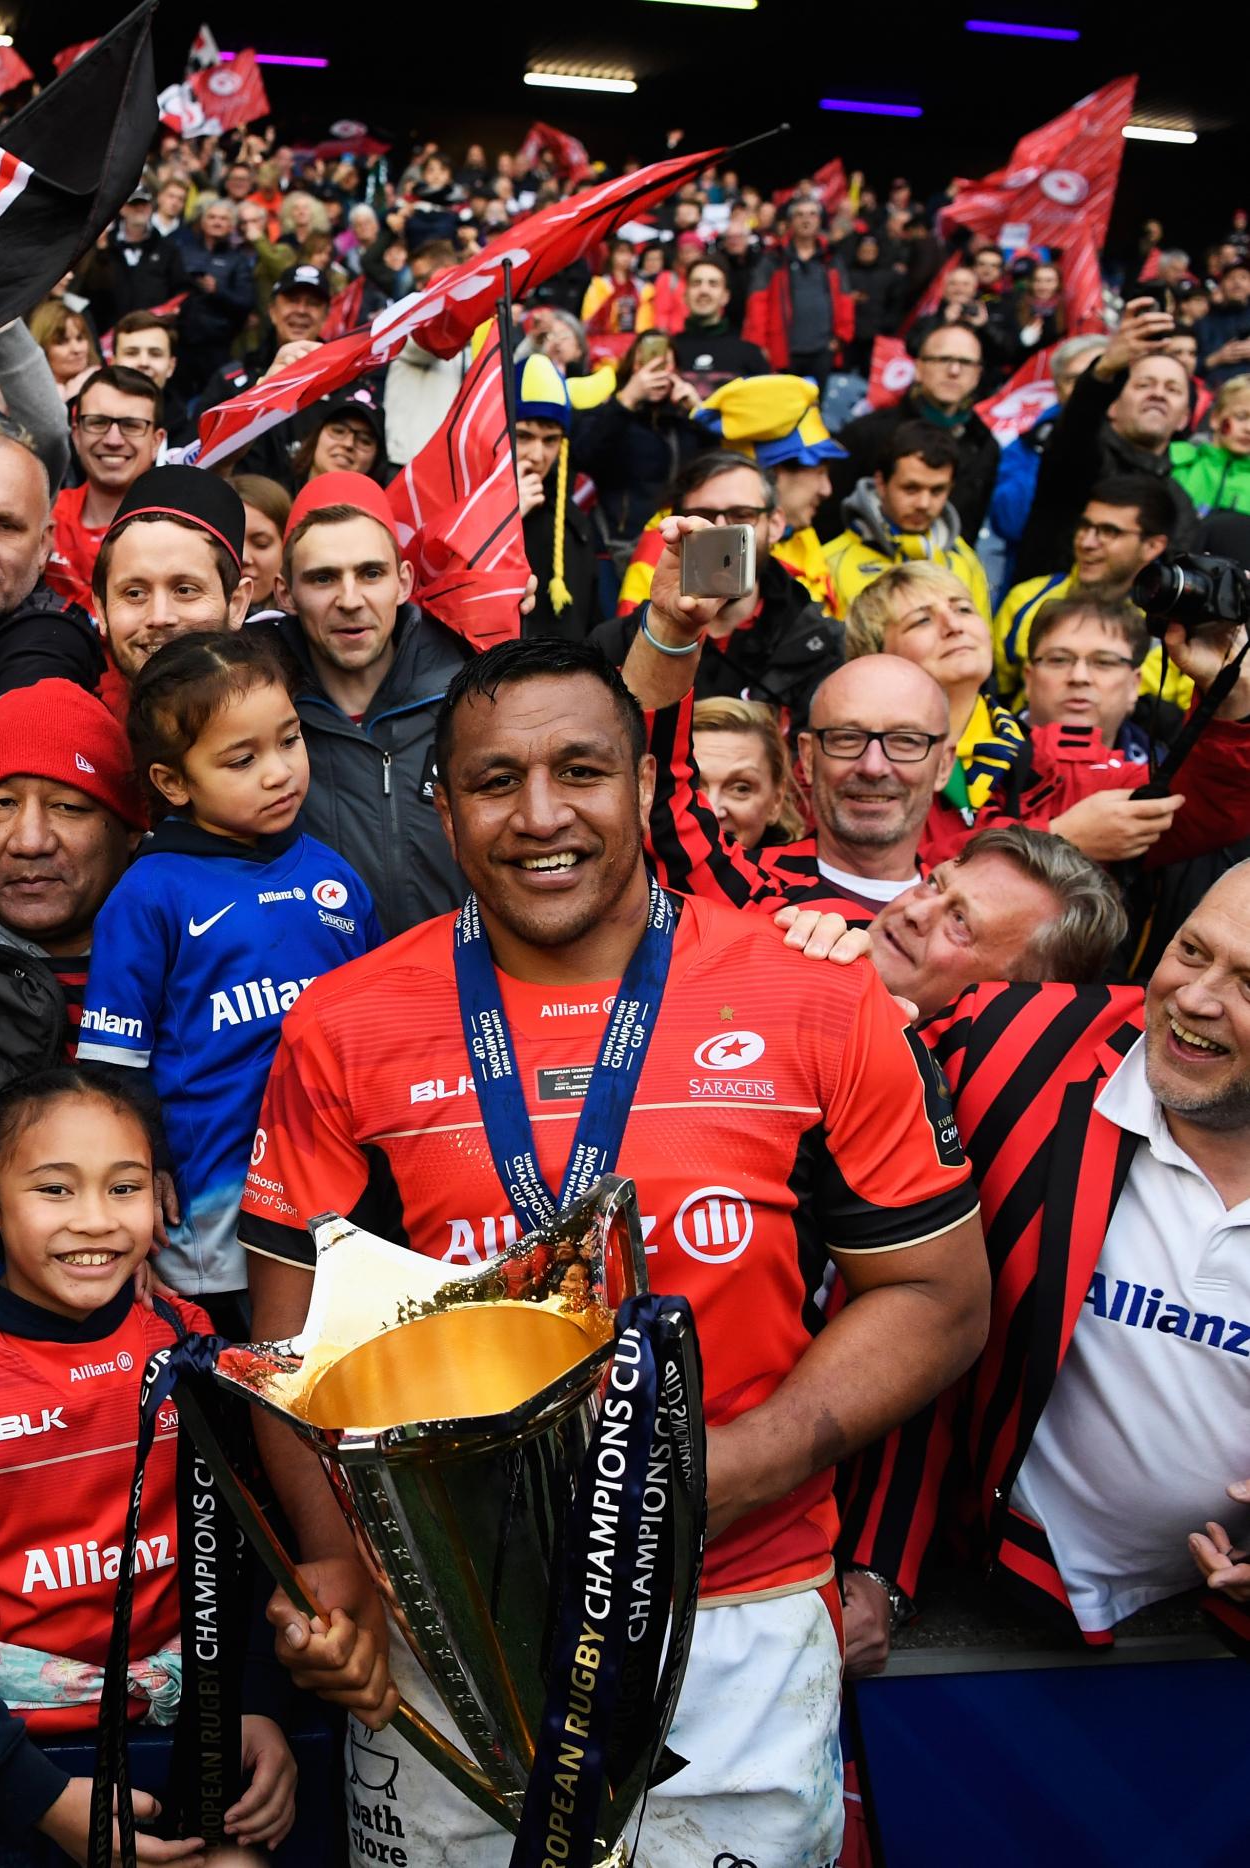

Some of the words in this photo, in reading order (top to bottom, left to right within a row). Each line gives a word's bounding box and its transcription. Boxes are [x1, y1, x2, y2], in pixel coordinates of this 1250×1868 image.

[257, 890, 293, 904] Allianz
[540, 1002, 599, 1018] Allianz
[472, 1036, 486, 1060] CUP
[479, 1011, 504, 1079] CHAMPIONS
[491, 1009, 507, 1049] EUROPEAN
[500, 1050, 513, 1076] RUGBY
[601, 1025, 619, 1067] EUROPEAN
[614, 999, 628, 1025] RUGBY
[611, 1000, 640, 1069] CHAMPIONS
[630, 1024, 646, 1048] CUP
[688, 1078, 776, 1097] SARACENS
[524, 1152, 544, 1194] EUROPEAN
[572, 1143, 586, 1173] RUGBY
[261, 1194, 275, 1206] of
[275, 1198, 298, 1218] Sport
[510, 1183, 528, 1208] CUP
[1084, 1271, 1250, 1358] Allianz
[69, 1360, 117, 1383] Allianz
[21, 1534, 175, 1594] Allianz
[627, 1442, 672, 1644] CHAMPIONS
[193, 1493, 219, 1661] CHAMPIONS
[564, 1620, 606, 1739] RUGBY
[585, 1398, 633, 1620] CHAMPIONS
[197, 1664, 222, 1745] RUGBY
[352, 1795, 406, 1839] bath
